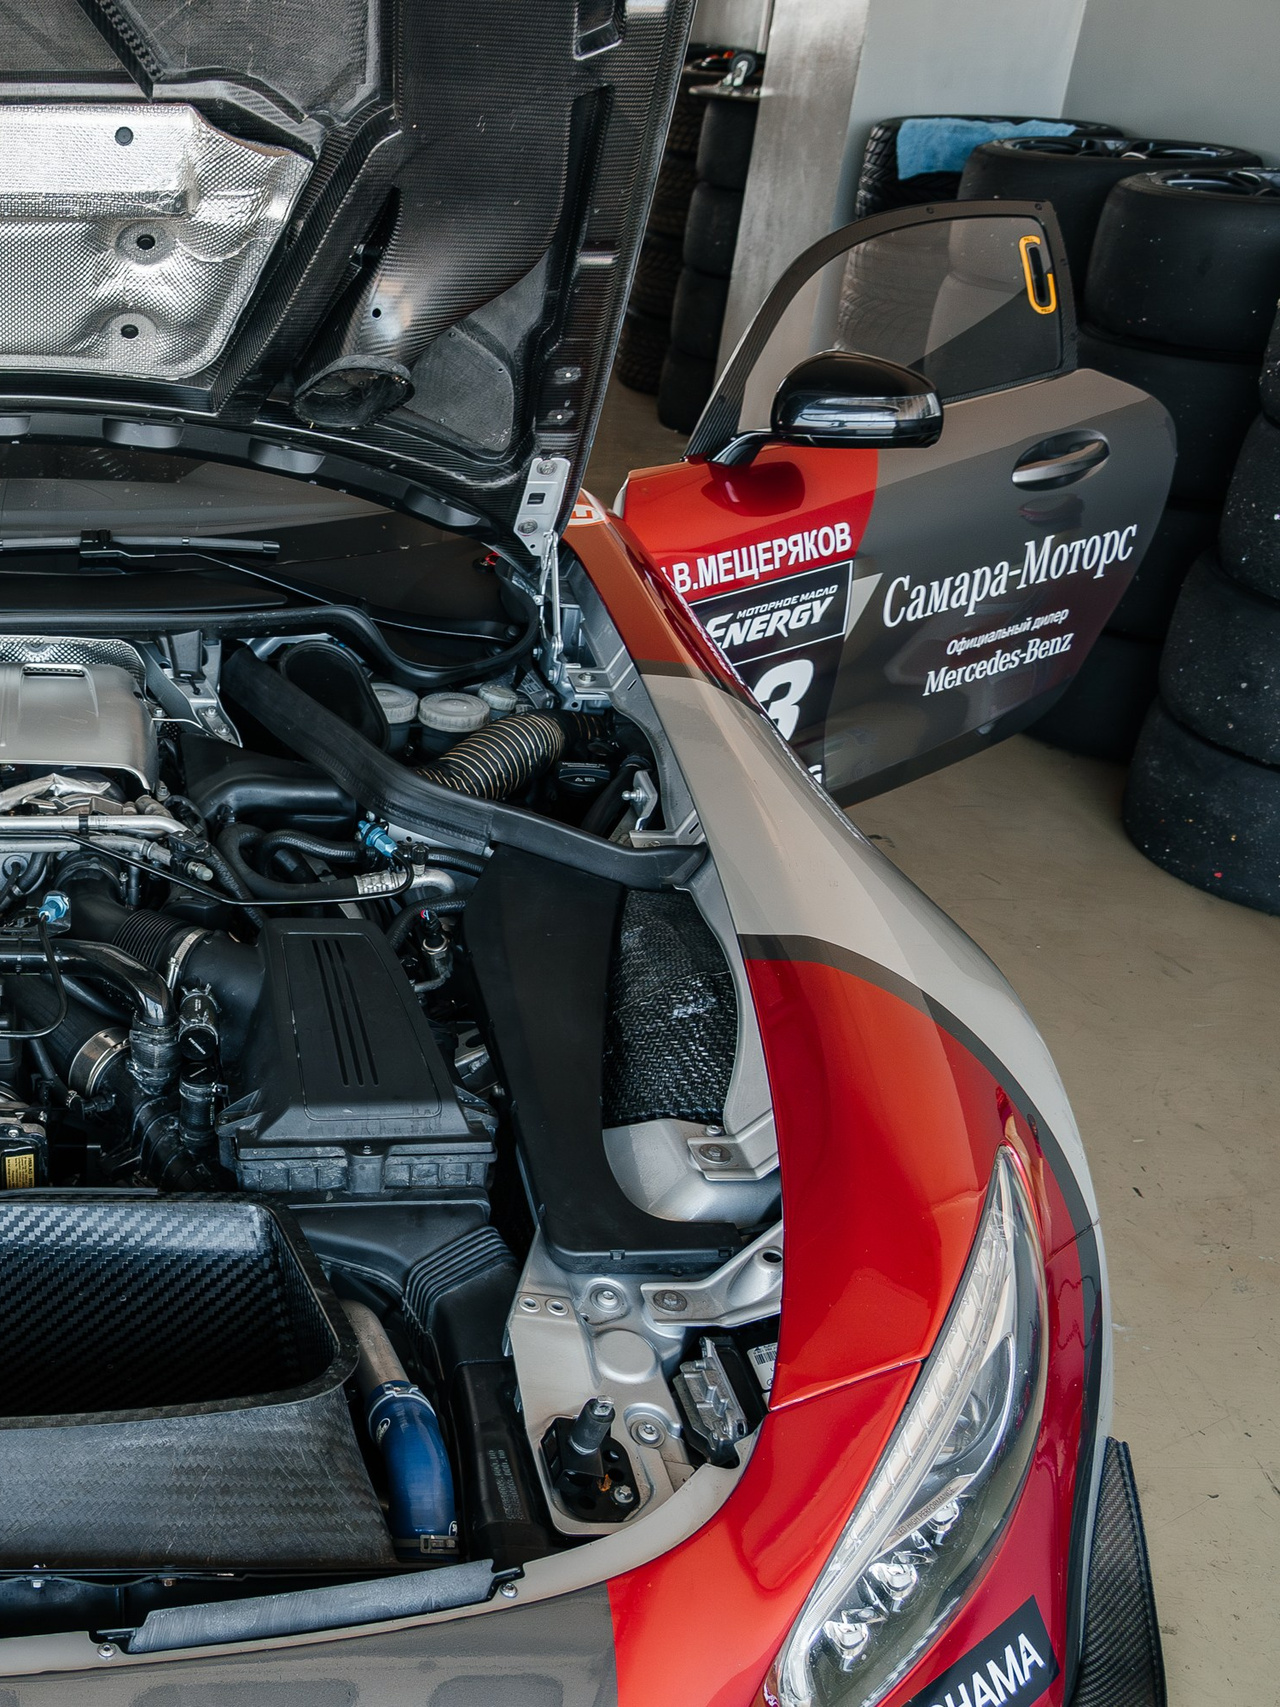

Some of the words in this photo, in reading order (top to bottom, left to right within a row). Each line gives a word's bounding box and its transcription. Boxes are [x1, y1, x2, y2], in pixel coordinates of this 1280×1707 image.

[673, 522, 852, 594] В.МЕЩЕРЯКОВ
[883, 524, 1138, 628] Самара-Моторс
[736, 596, 800, 620] МОТОРНОЕ
[799, 584, 839, 603] МАСЛО
[946, 616, 1032, 656] Официальный
[1030, 608, 1070, 632] дилер
[922, 632, 1075, 697] Mercedes-Benz
[917, 1486, 957, 1520] PERFORMANCE
